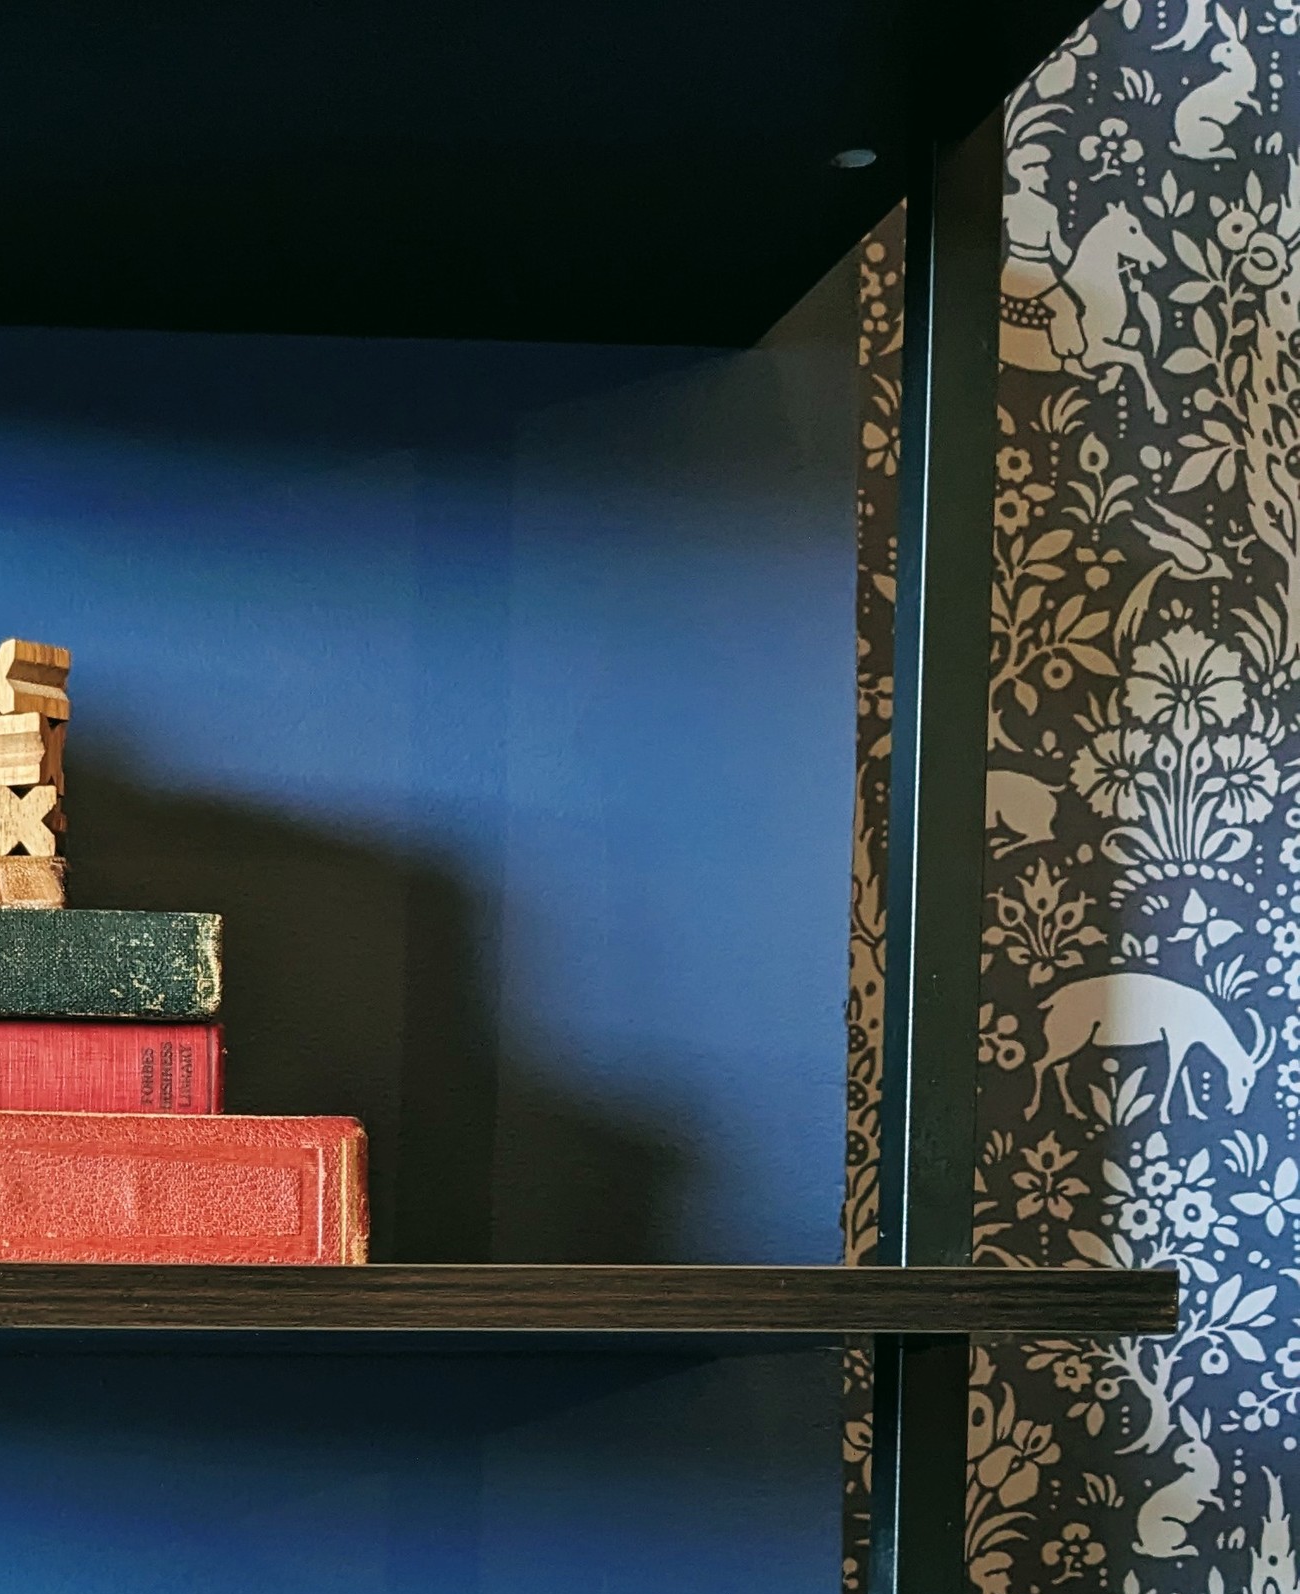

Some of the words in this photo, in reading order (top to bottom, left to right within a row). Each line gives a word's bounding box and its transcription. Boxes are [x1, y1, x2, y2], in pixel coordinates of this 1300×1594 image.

[140, 1047, 154, 1105] FORBES
[159, 1041, 173, 1110] BUSINESS
[178, 1042, 192, 1108] LIBRARY
